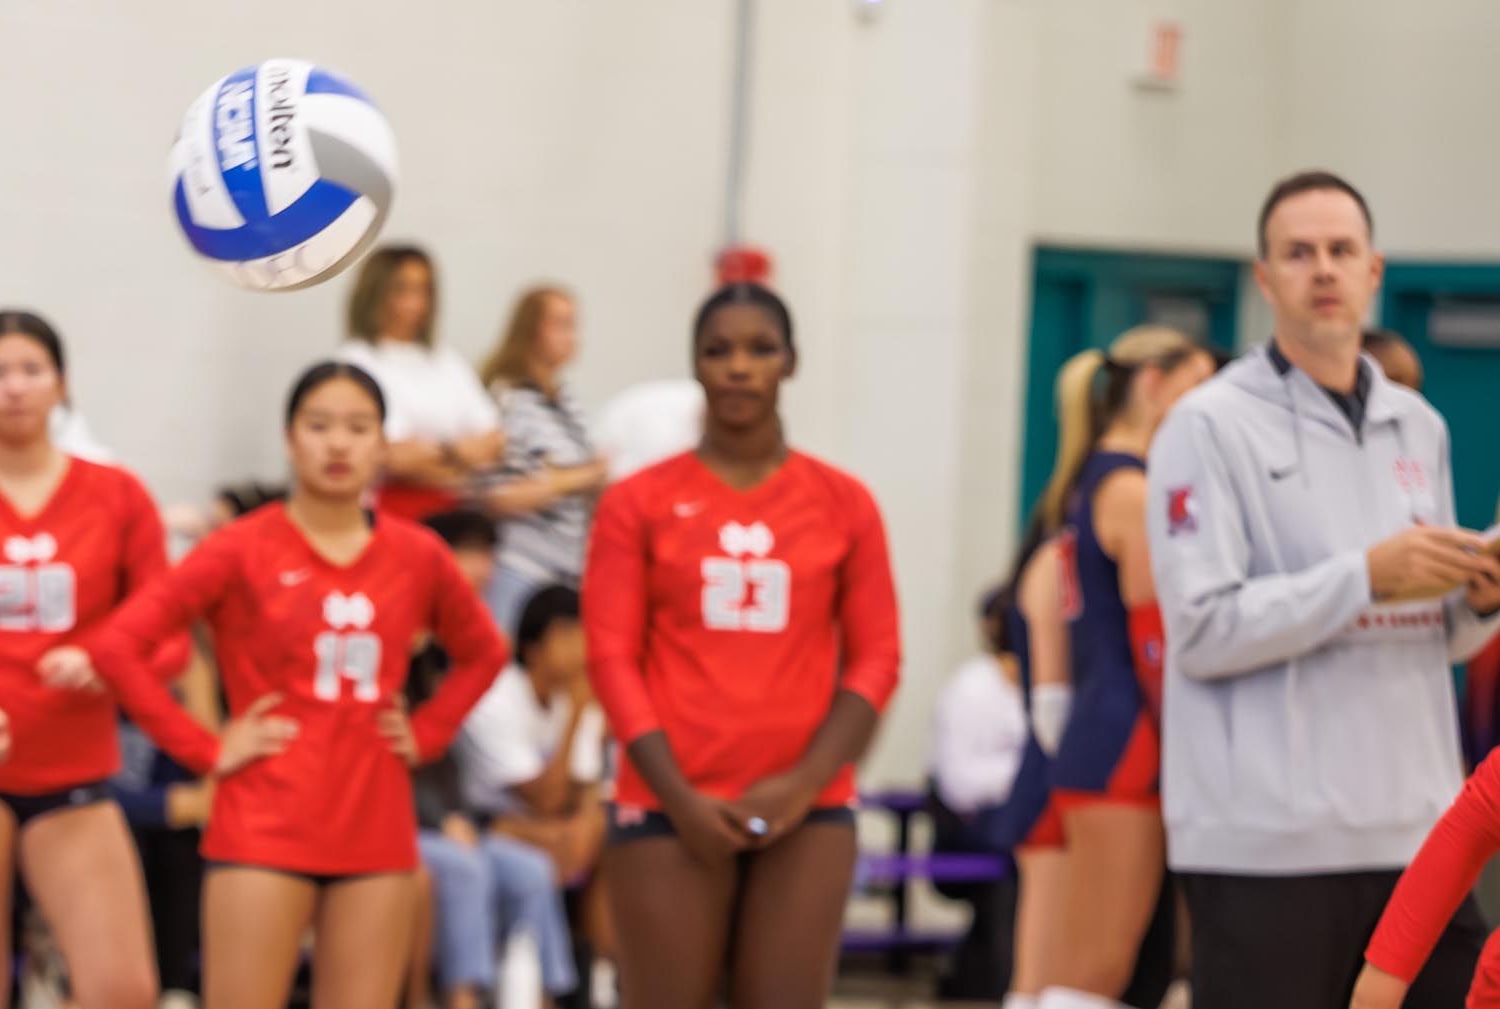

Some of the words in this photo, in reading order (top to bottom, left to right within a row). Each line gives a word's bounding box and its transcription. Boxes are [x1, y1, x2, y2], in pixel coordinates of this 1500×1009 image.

[217, 79, 257, 172] NCAA
[700, 556, 792, 632] 23
[314, 631, 382, 702] 19
